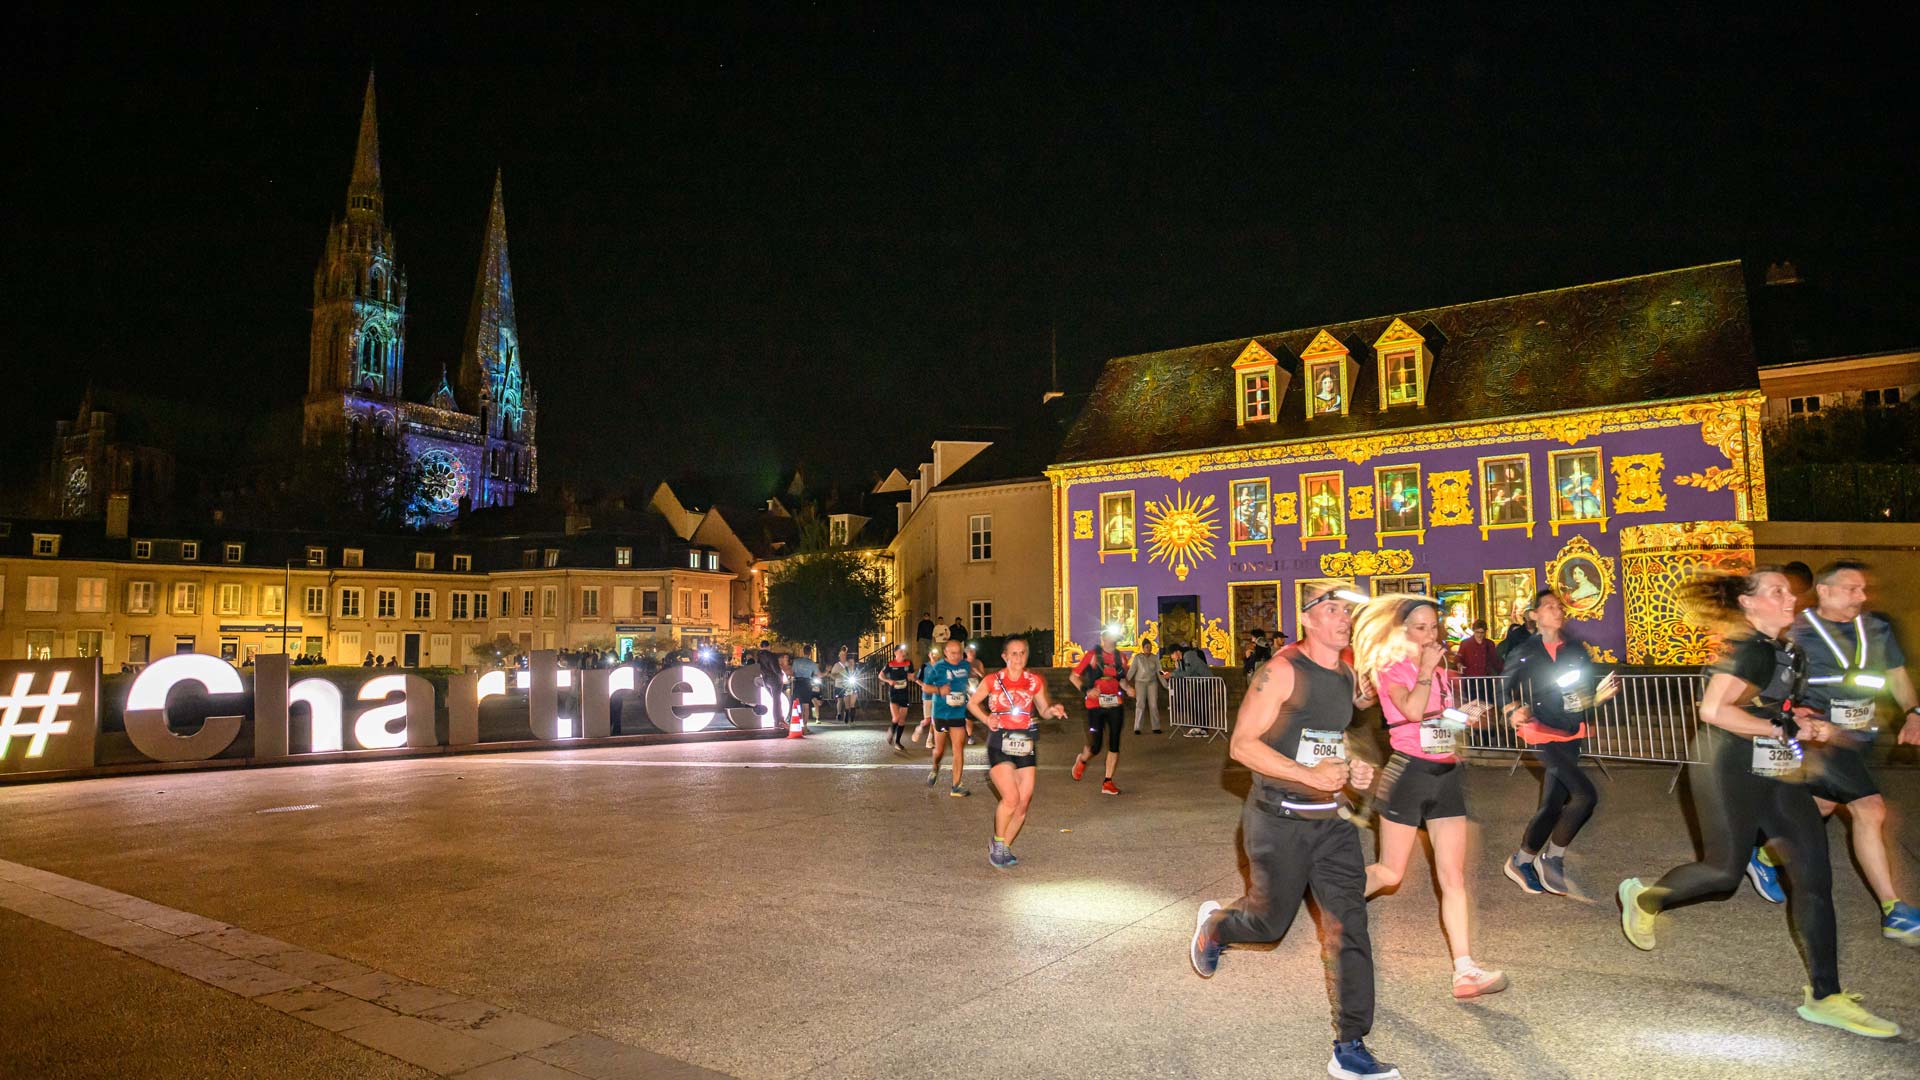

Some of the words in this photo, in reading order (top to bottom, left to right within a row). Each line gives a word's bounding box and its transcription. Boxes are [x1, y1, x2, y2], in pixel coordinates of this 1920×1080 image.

[0, 650, 790, 762] #Chartres
[1844, 706, 1870, 718] 5250
[1313, 743, 1338, 756] 6084
[1768, 749, 1793, 761] 3205
